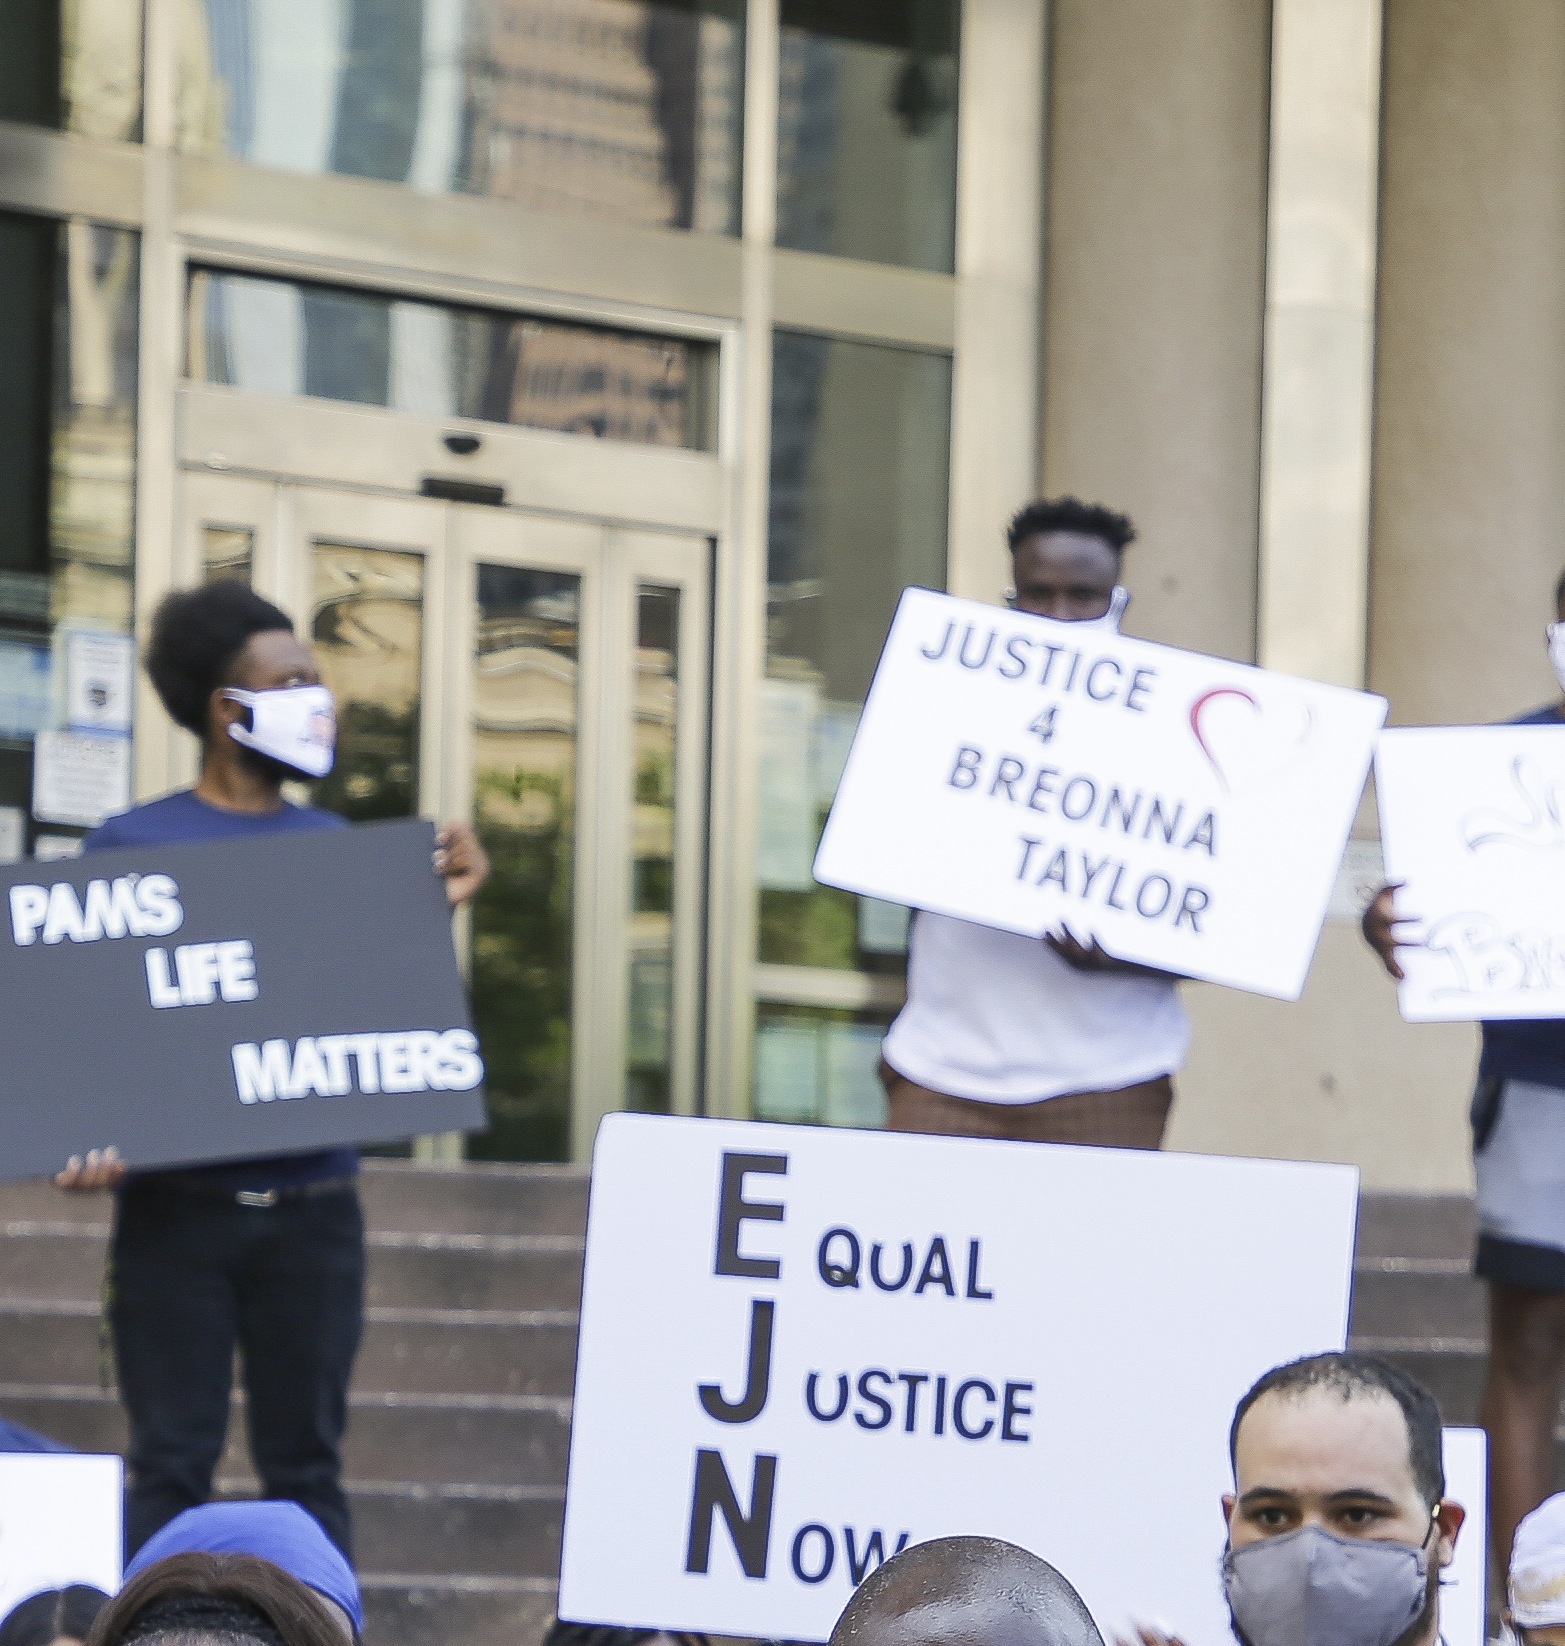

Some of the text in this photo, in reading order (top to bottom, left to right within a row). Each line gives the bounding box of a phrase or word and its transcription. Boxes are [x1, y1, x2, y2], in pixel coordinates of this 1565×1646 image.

[921, 620, 1159, 714] JUSTICE
[1028, 705, 1060, 744] 4
[948, 745, 1219, 857] BREONNA
[1014, 836, 1212, 934] TAYLOR
[144, 939, 260, 1010] LIFE
[232, 1028, 485, 1105] MATTERS
